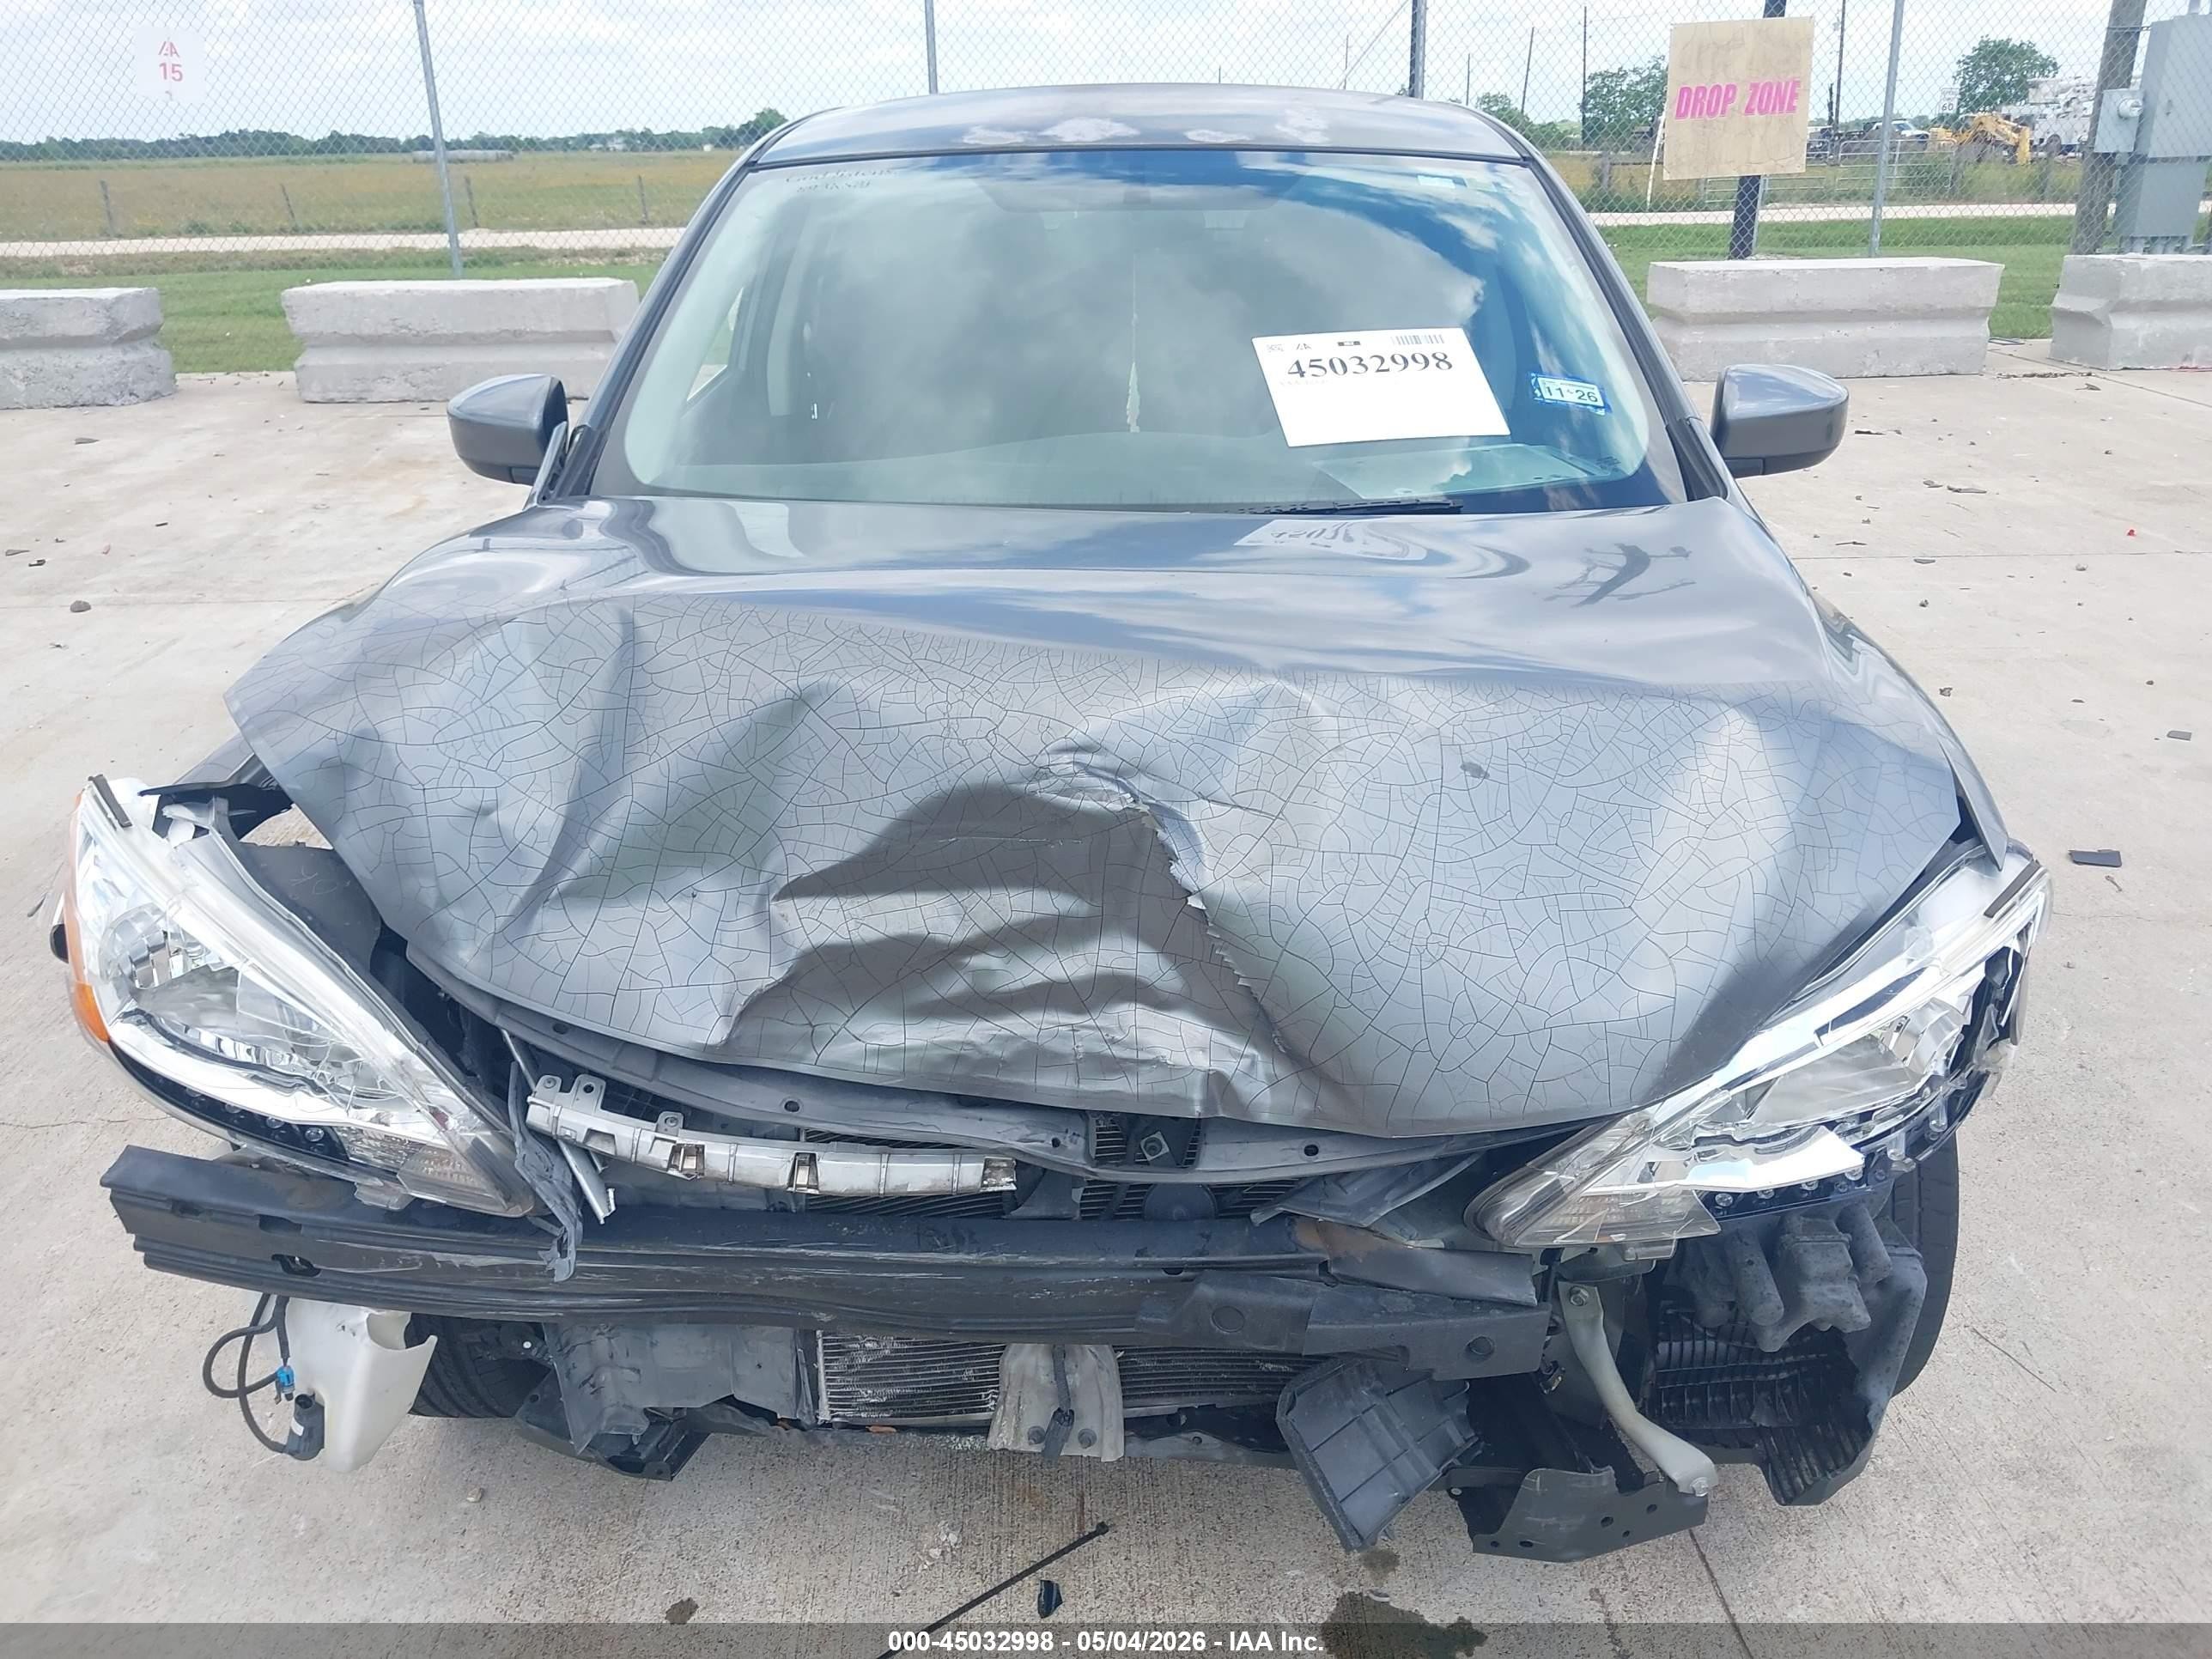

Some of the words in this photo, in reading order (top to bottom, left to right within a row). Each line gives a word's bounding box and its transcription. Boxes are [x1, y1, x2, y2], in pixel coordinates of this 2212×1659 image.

[159, 62, 183, 82] 15
[1675, 83, 1738, 120] DROP
[1744, 77, 1801, 116] ZONE
[1941, 102, 1954, 111] 60
[1287, 351, 1453, 378] 45032998
[1545, 386, 1565, 398] 11
[1575, 389, 1599, 403] 26
